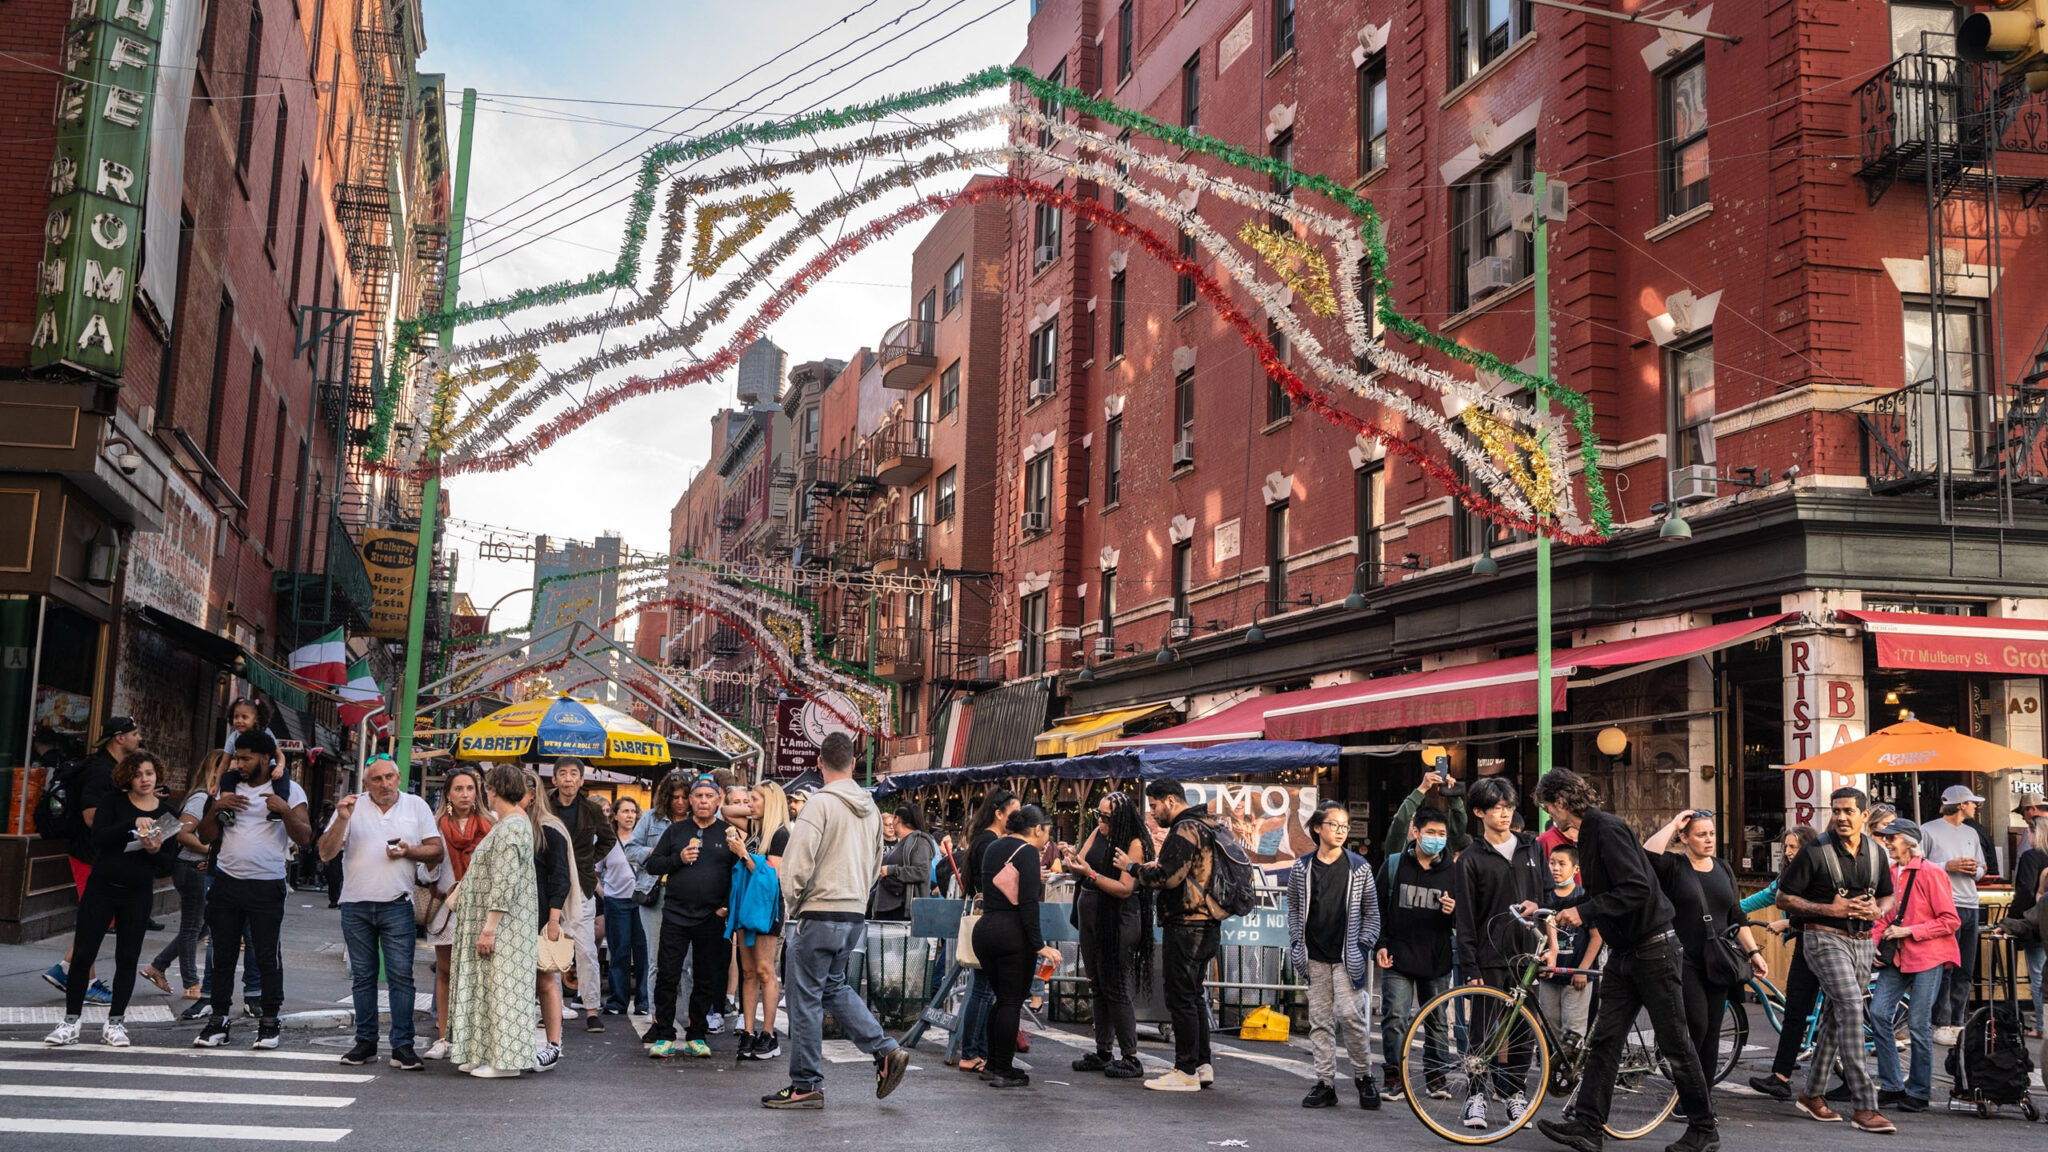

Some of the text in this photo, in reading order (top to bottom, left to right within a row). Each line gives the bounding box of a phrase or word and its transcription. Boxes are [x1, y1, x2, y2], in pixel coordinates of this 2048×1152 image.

[77, 157, 135, 356] ROMA
[375, 541, 415, 556] Mulberry
[371, 551, 414, 565] Street Bar
[374, 573, 404, 584] Beer
[374, 598, 405, 609] asta
[1894, 648, 1992, 668] 177 Mulberry St.
[462, 736, 532, 751] SABRETT
[571, 741, 577, 749] A
[613, 739, 664, 757] SABRETT
[782, 748, 816, 756] Ristorante
[1878, 749, 1940, 764] APEROL
[1242, 914, 1290, 928] DO NO
[1221, 930, 1260, 942] YPD
[926, 1007, 943, 1022] POLICE
